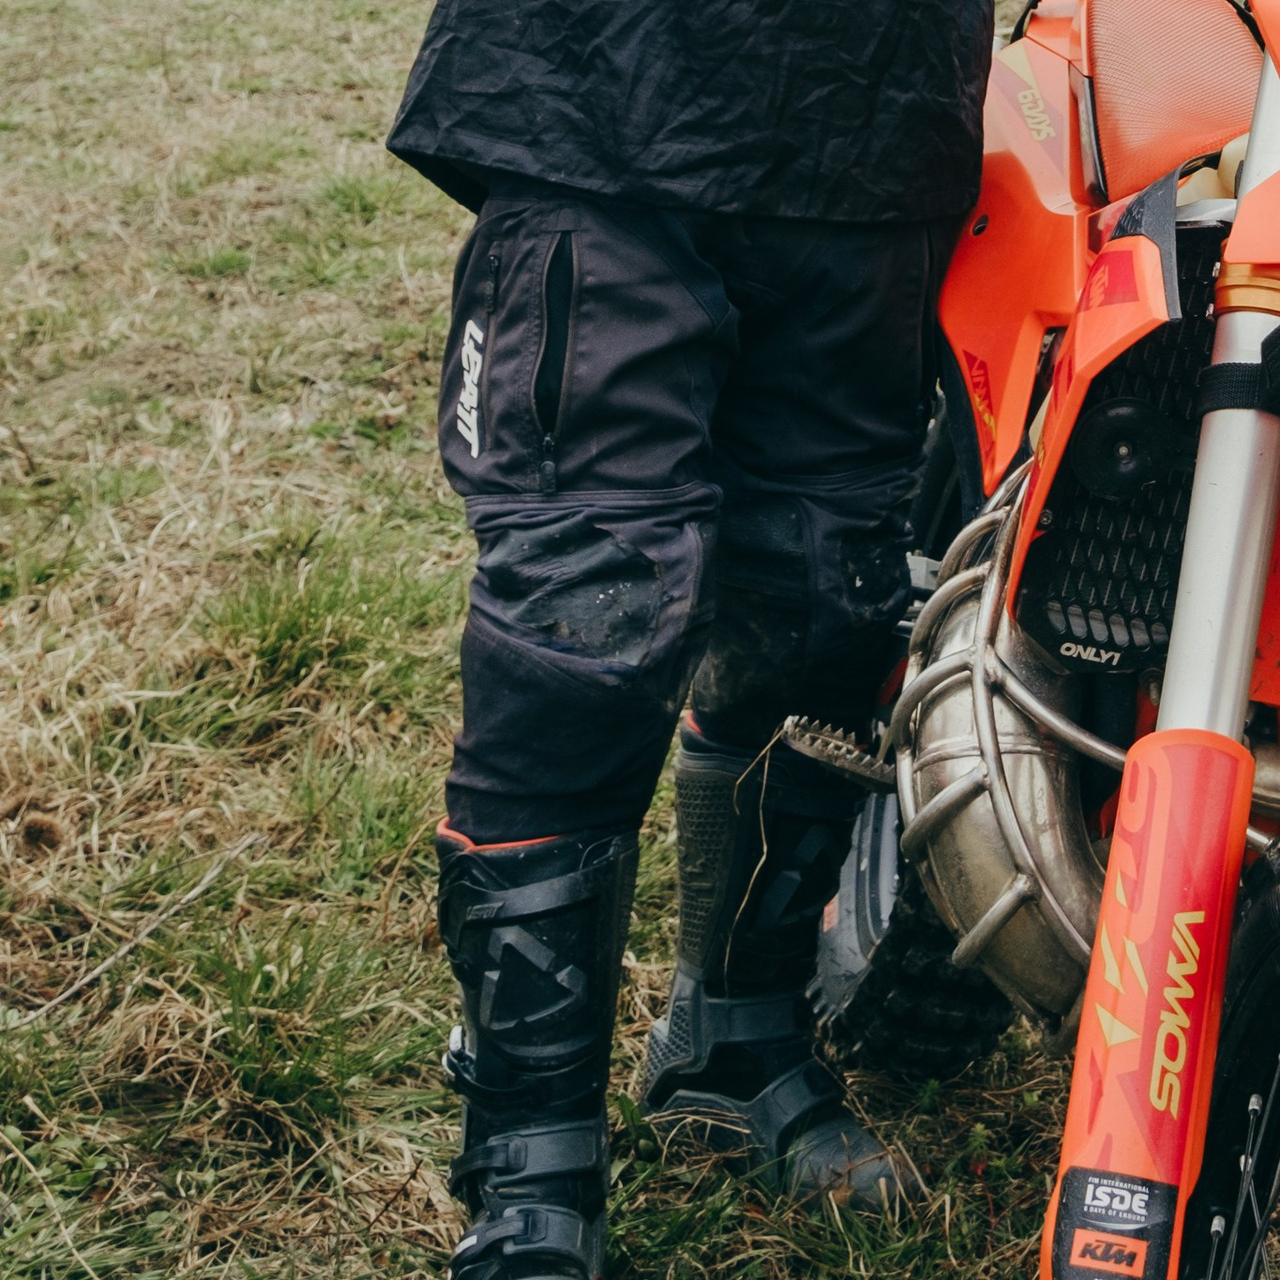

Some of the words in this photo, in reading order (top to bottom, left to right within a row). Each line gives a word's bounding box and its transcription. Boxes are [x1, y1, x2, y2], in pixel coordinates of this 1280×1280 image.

[457, 320, 484, 459] LEATT
[1060, 642, 1121, 666] ONLY1
[1150, 911, 1205, 1120] VAMOS
[1088, 1176, 1100, 1184] FIM
[1101, 1178, 1149, 1194] INTERNATIONAL
[1084, 1183, 1149, 1215] ISDE
[1089, 1206, 1105, 1214] DAYS
[1107, 1209, 1117, 1217] OF
[1119, 1211, 1146, 1222] ENDURO
[1079, 1240, 1137, 1267] KTM
